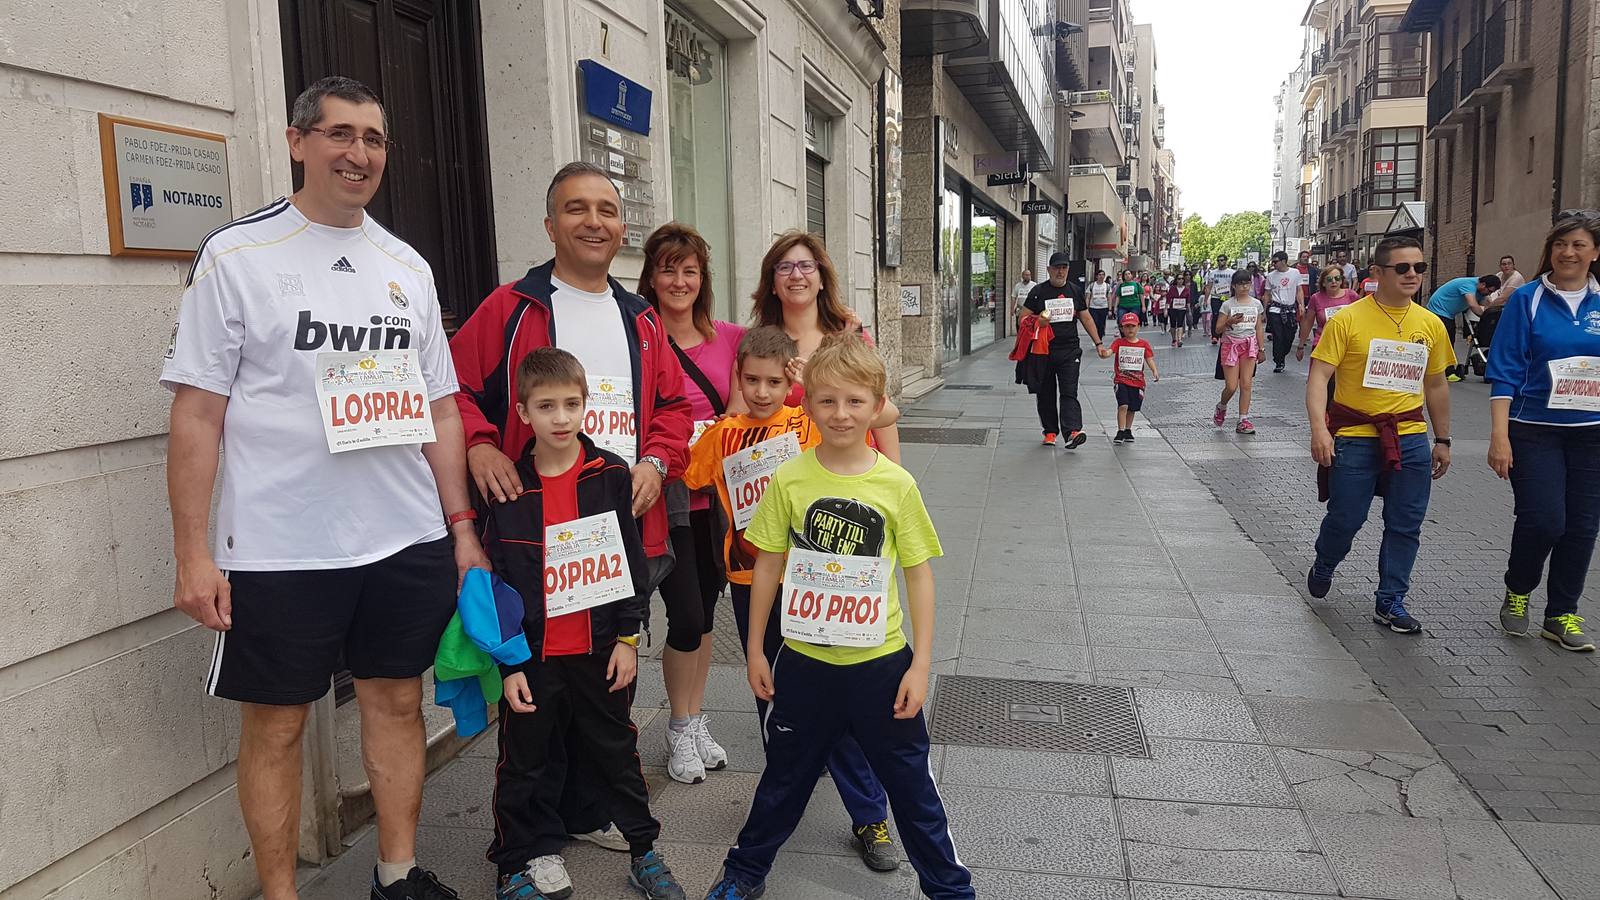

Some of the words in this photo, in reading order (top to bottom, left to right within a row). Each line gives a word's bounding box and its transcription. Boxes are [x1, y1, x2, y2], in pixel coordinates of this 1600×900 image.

[600, 21, 608, 55] 7
[125, 136, 147, 150] PABLO
[150, 141, 192, 157] FDEZ-PRIDA
[194, 149, 220, 161] CASADO
[126, 152, 154, 164] CARMEN
[156, 157, 195, 170] FDEZ-PRIDA
[196, 162, 221, 175] CASADO
[163, 189, 223, 208] NOTARIOS
[1027, 203, 1047, 212] Sfera
[331, 266, 357, 274] adidas
[294, 311, 411, 352] bwin
[384, 315, 411, 328] com
[331, 390, 424, 427] LOSPRA2
[580, 409, 605, 436] OS
[735, 475, 771, 511] LOSP
[813, 512, 845, 537] PARTY
[844, 523, 865, 544] TILL
[816, 529, 835, 550] THE
[837, 537, 857, 556] END
[544, 553, 622, 595] OSPRA2
[787, 588, 824, 620] LOS
[825, 594, 882, 625] PROS
